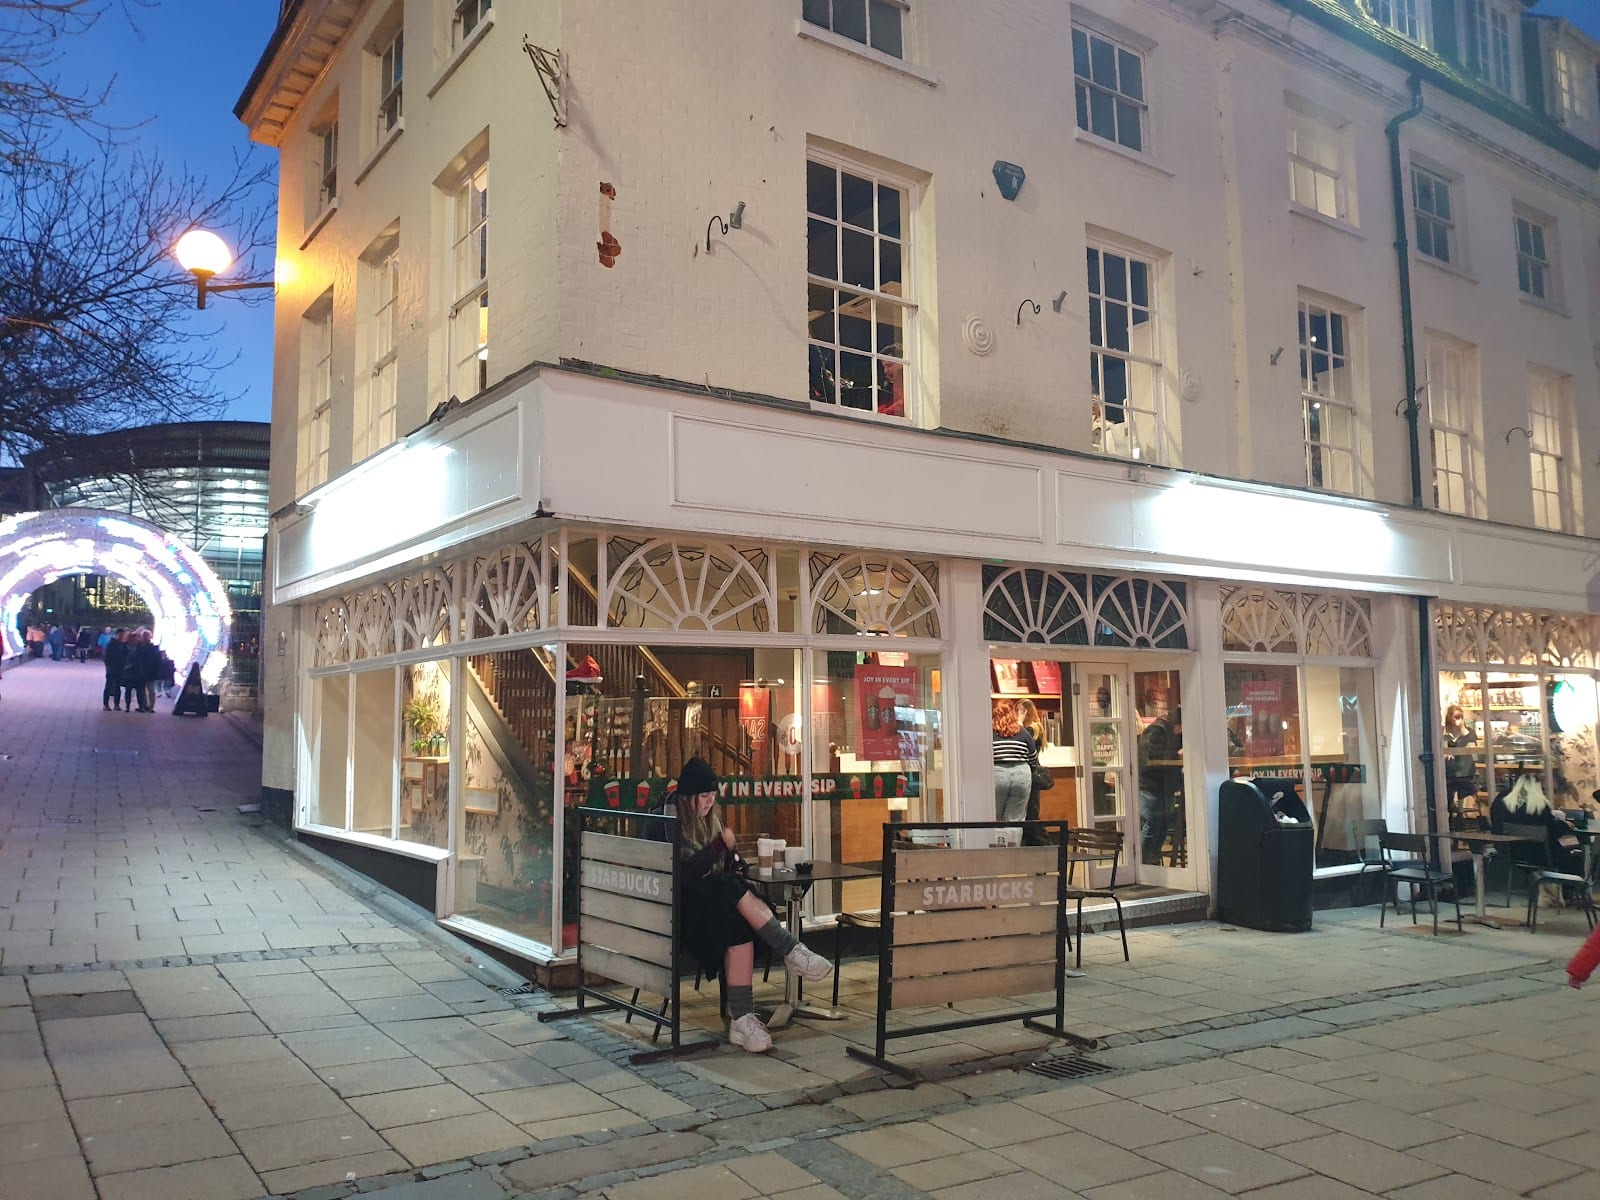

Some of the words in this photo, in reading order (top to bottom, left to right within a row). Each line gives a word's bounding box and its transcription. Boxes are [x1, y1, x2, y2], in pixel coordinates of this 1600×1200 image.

[731, 780, 751, 797] IN
[753, 780, 803, 797] EVERY
[811, 778, 837, 794] SIP
[591, 866, 660, 896] STARBUCKS
[923, 881, 1034, 906] STARBUCKS
